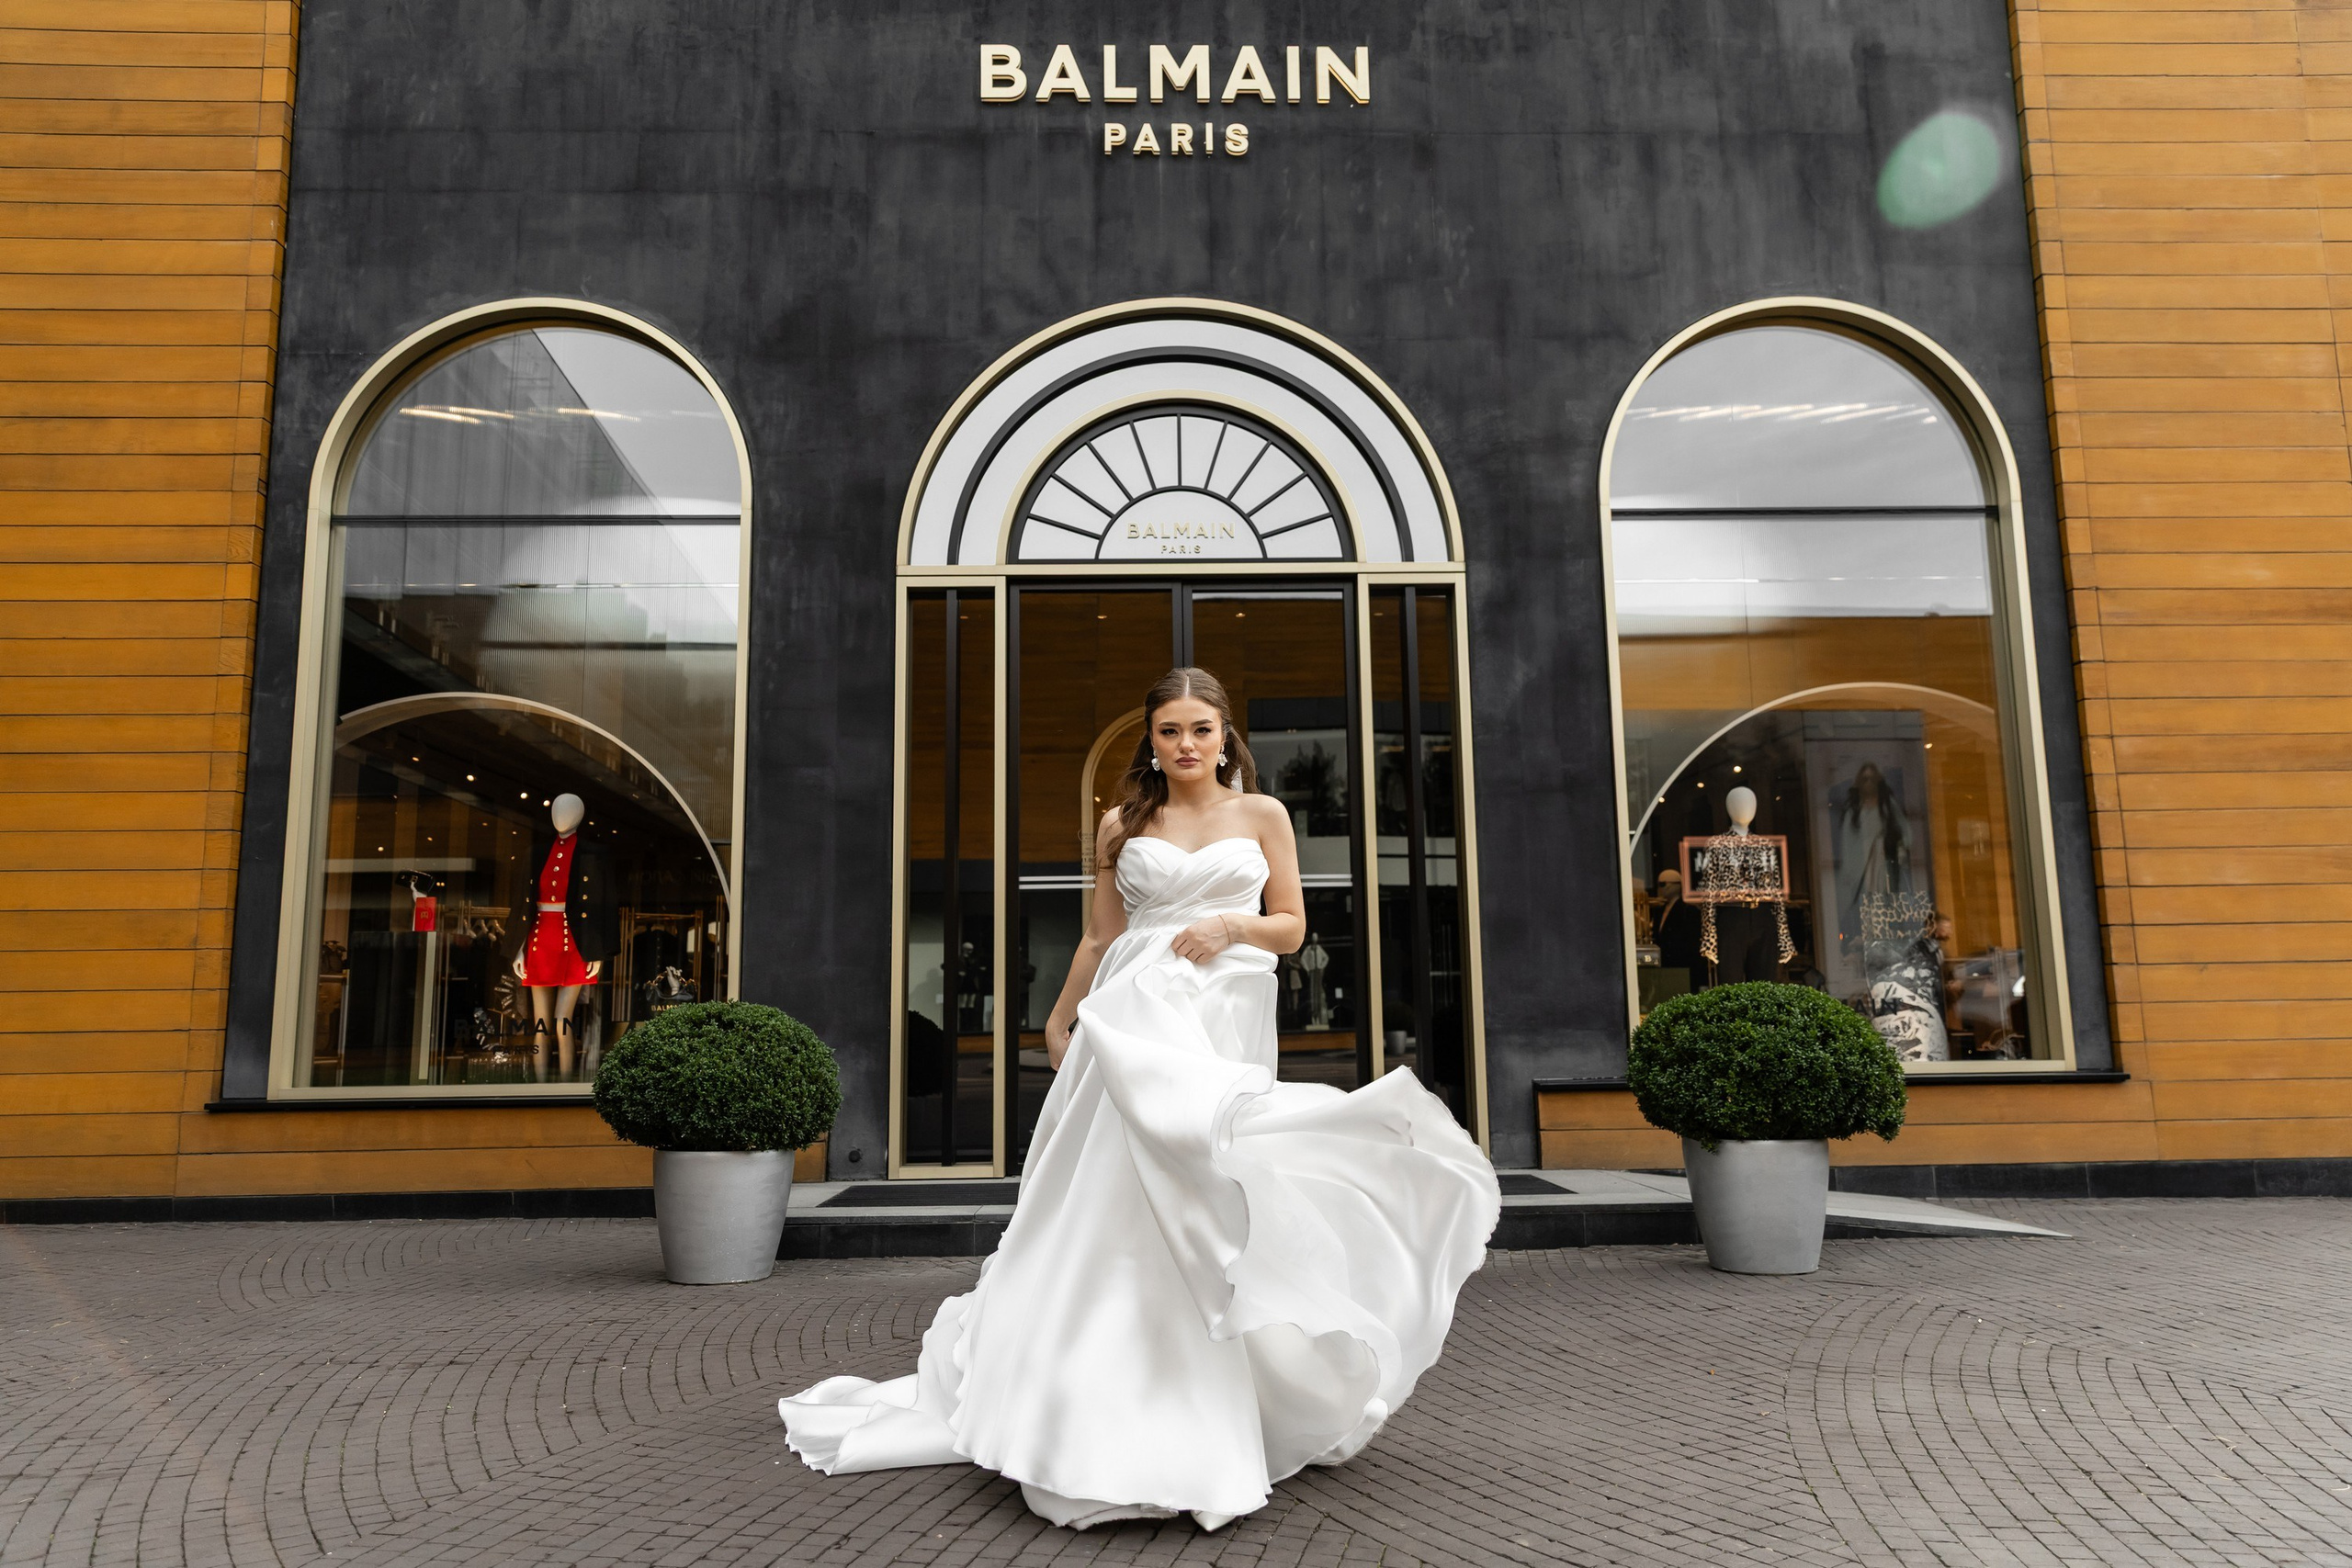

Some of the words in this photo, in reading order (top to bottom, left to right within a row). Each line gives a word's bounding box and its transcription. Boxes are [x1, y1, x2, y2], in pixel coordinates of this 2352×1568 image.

[979, 44, 1370, 103] BALMAIN
[1103, 122, 1250, 155] PARIS
[1126, 522, 1236, 539] BALMAIN
[1160, 545, 1202, 554] PARIS
